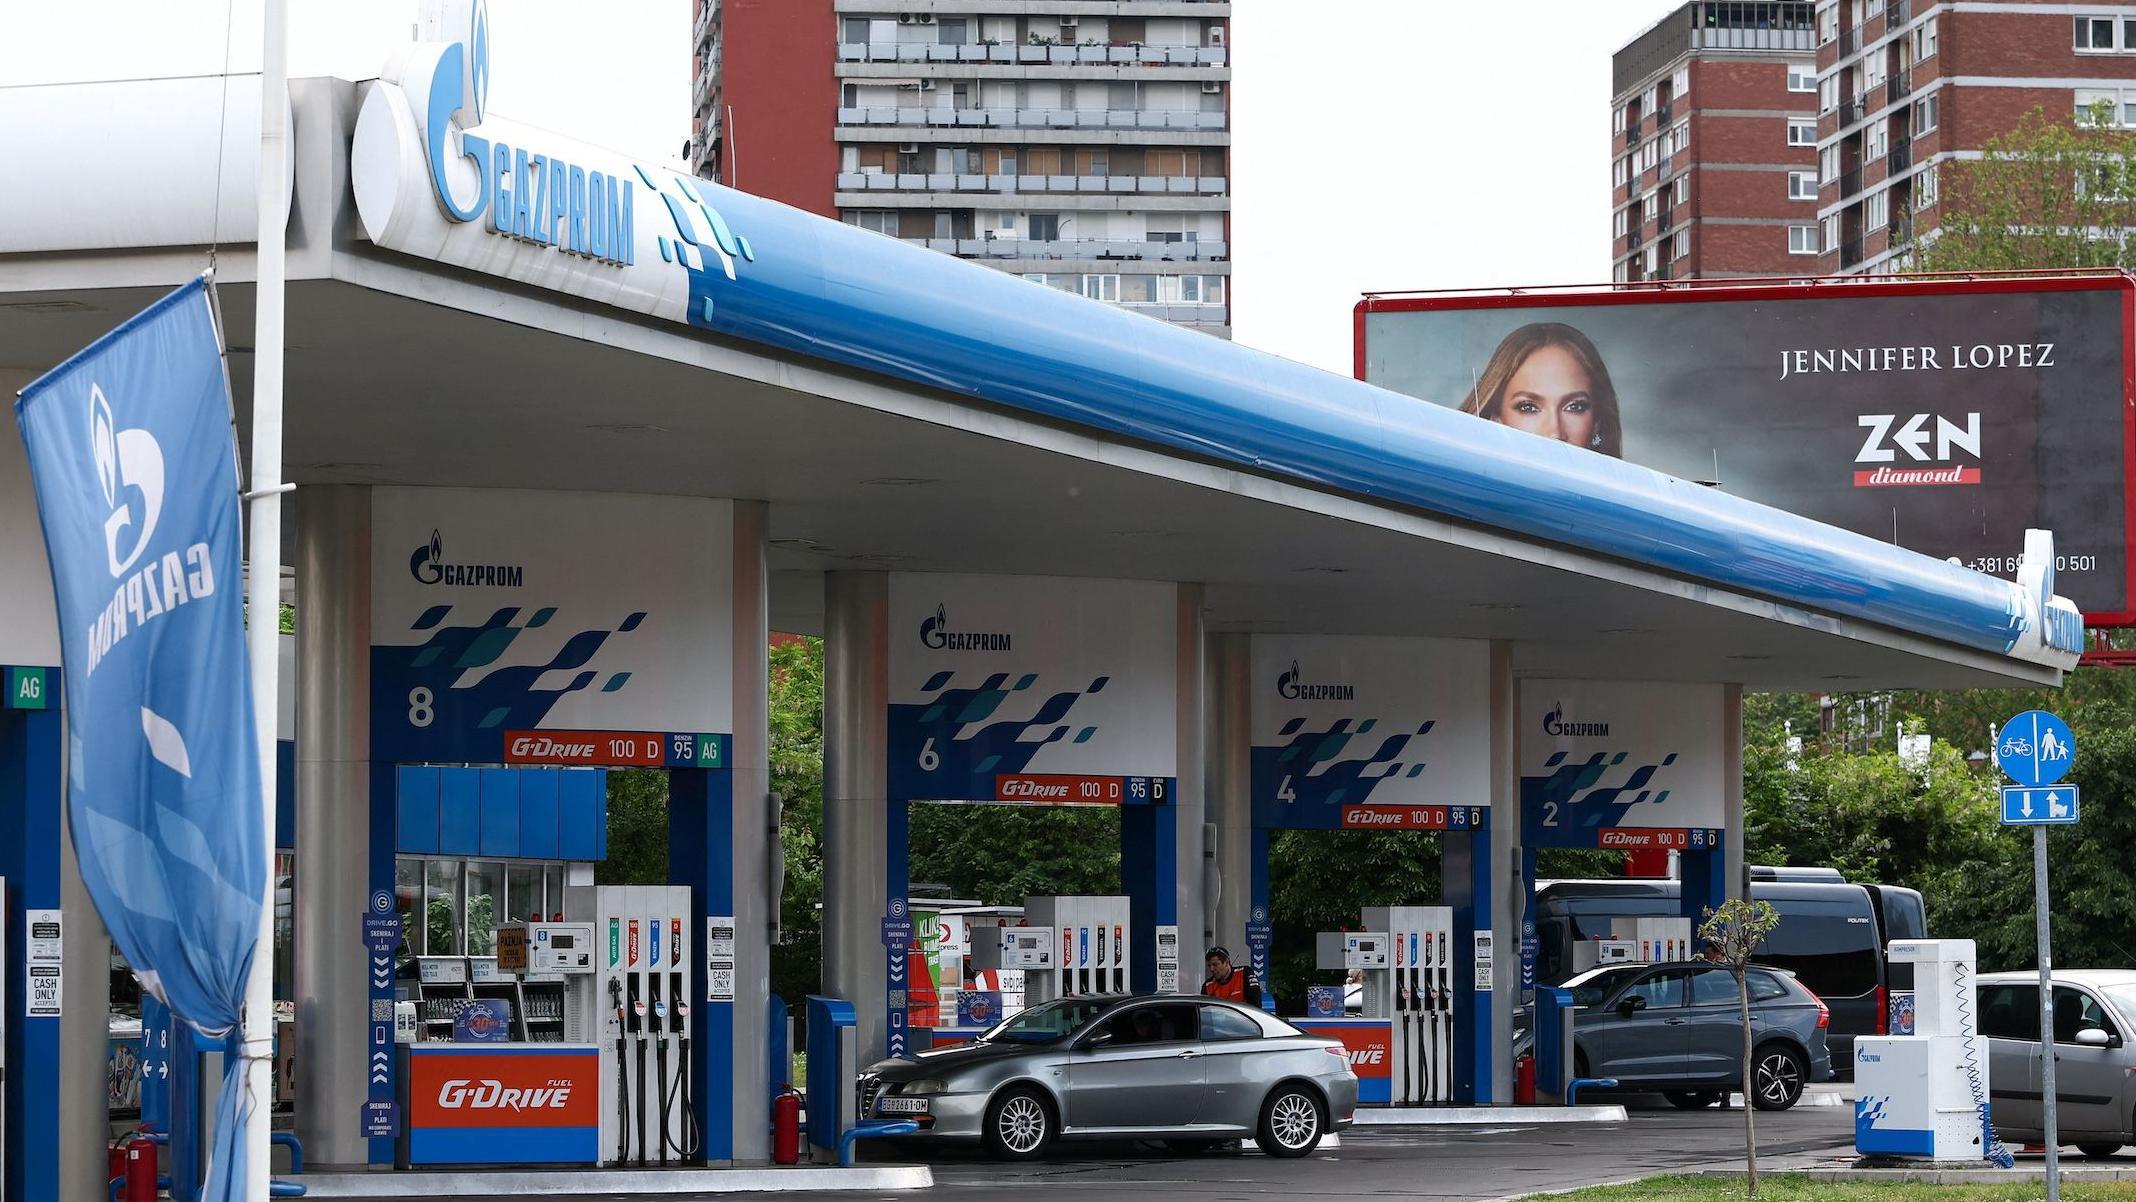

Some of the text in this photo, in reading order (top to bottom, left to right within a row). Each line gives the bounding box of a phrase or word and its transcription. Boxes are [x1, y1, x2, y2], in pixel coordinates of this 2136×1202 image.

[493, 142, 634, 266] GAZPROM
[1780, 343, 2055, 380] JENNIFER LOPEZ
[1855, 412, 1981, 463] ZEN
[1869, 464, 1963, 485] diamond
[1967, 557, 2001, 572] +381
[2070, 556, 2096, 571] 501
[444, 564, 523, 587] GAZPROM
[948, 632, 1011, 651] GAZPROM
[19, 677, 40, 698] AG
[1301, 684, 1354, 700] GAZPROM
[408, 686, 434, 727] 8
[1563, 722, 1609, 737] GAZPROM
[608, 739, 635, 758] 100
[647, 740, 659, 759] D
[674, 741, 693, 759] 95
[702, 742, 717, 759] AG
[919, 737, 940, 771] 6
[1080, 782, 1100, 797] 100
[1109, 783, 1119, 798] D
[1131, 783, 1146, 798] 95
[1154, 783, 1163, 799] D
[1276, 774, 1296, 804] 4
[1411, 811, 1428, 824] 100
[1436, 811, 1444, 824] D
[1452, 811, 1465, 824] 95
[1472, 812, 1480, 825] D
[1543, 801, 1558, 827] 2
[1657, 833, 1672, 845] 100
[1678, 833, 1685, 845] D
[1693, 834, 1703, 845] 95
[1709, 834, 1715, 846] D
[539, 931, 546, 941] 8
[34, 979, 57, 989] CASH
[713, 971, 730, 980] CASH
[714, 980, 729, 988] ONLY
[35, 989, 56, 1000] ONLY
[145, 1028, 167, 1048] 7 8
[547, 1079, 573, 1087] FUEL
